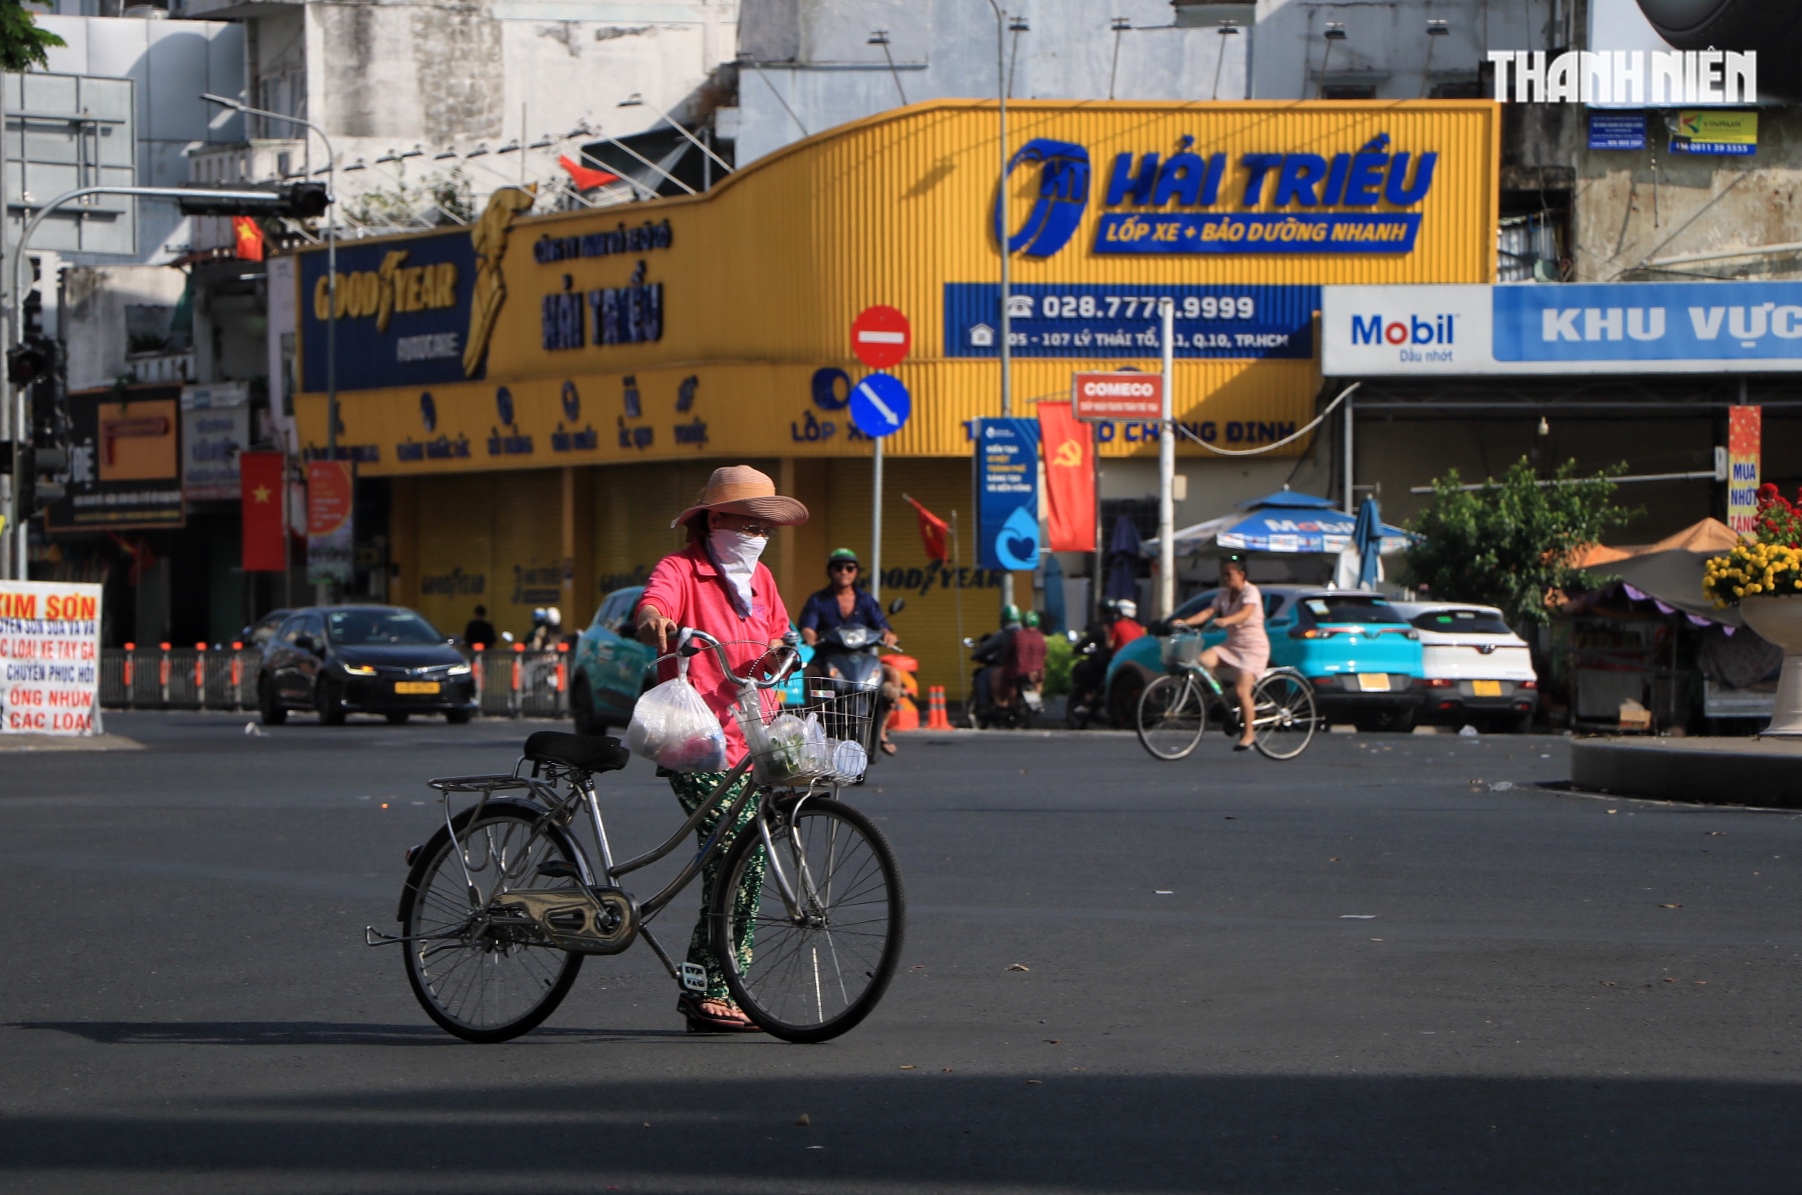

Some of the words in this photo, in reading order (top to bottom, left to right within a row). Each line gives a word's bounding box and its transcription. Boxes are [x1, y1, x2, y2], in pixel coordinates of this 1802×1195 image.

[1105, 133, 1228, 206] HẢI
[1106, 215, 1150, 242] LỐP
[1152, 223, 1181, 241] XE
[1201, 217, 1245, 242] BẢO
[1246, 216, 1328, 242] DƯỠNG
[1330, 223, 1408, 242] NHANH
[1008, 332, 1028, 347] 05
[1042, 332, 1071, 347] 107
[1095, 328, 1133, 347] THÁI
[1351, 313, 1454, 346] Mobil
[1542, 307, 1666, 342] KHU
[1687, 301, 1802, 348] VỰC
[1084, 382, 1155, 397] COMECO
[847, 420, 875, 442] X
[1126, 416, 1217, 442] CHNG
[1733, 463, 1756, 480] MUA
[46, 591, 96, 621] SƠN
[41, 640, 53, 659] XE
[57, 641, 78, 659] TAY
[81, 641, 95, 660] GA
